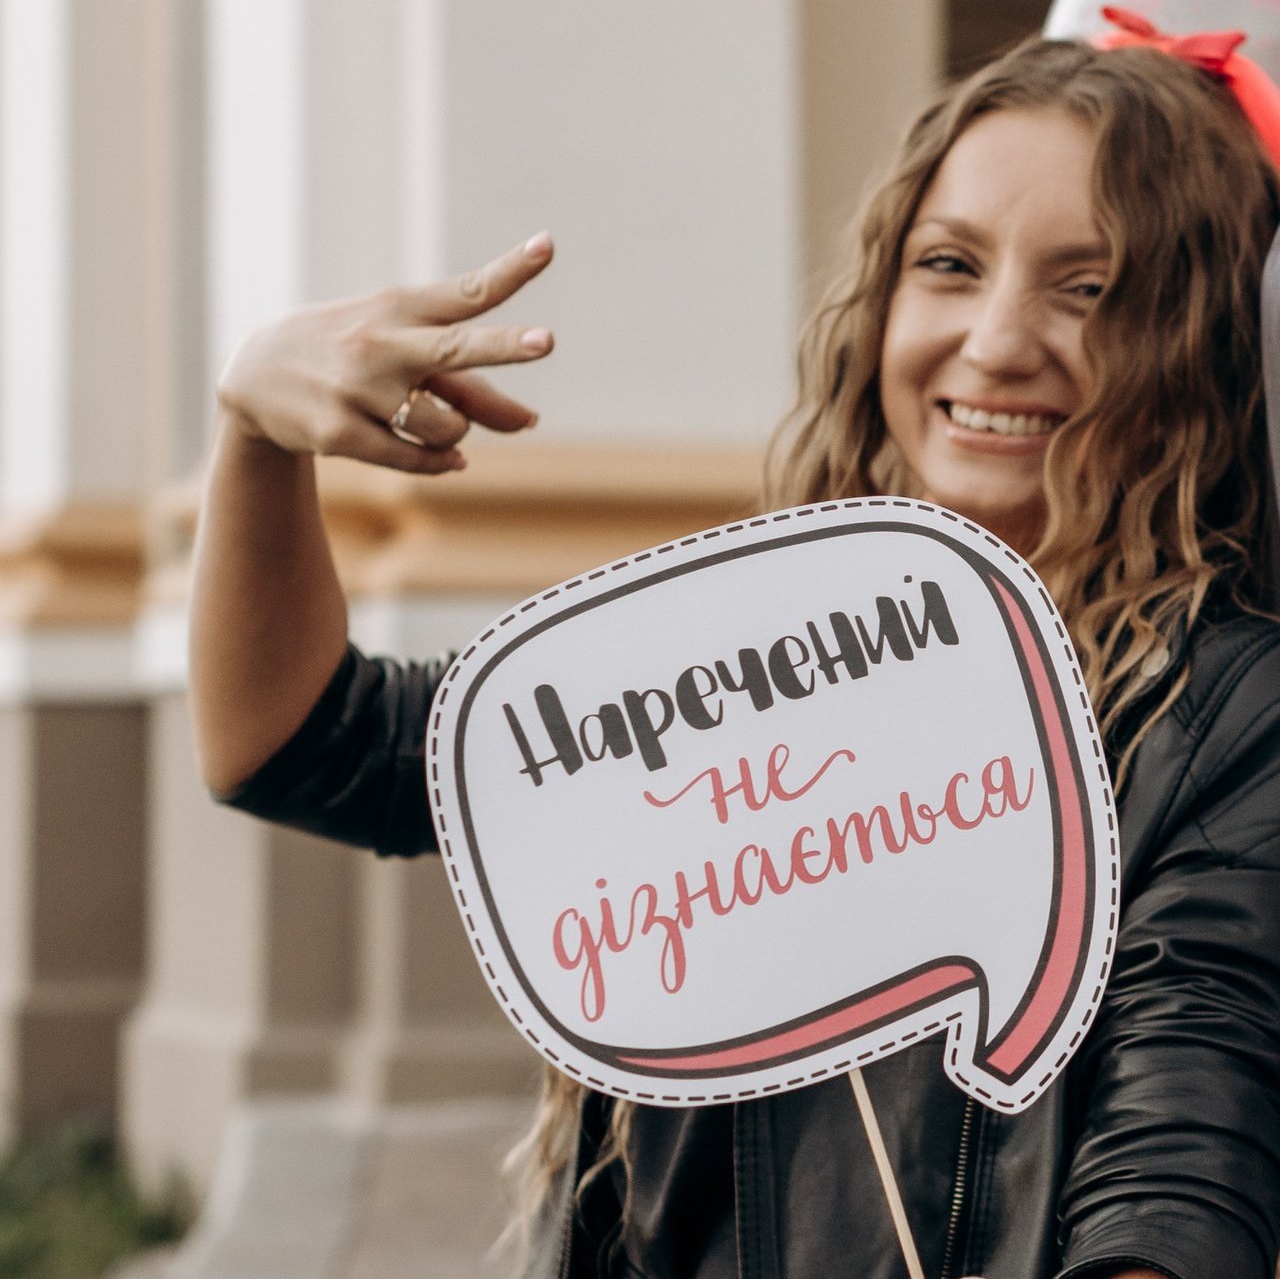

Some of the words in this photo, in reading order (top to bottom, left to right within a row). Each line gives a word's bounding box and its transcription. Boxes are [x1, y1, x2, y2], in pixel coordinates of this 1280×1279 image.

[502, 575, 960, 787] Наречений
[643, 743, 857, 824] не
[552, 755, 1034, 1023] дізнається
